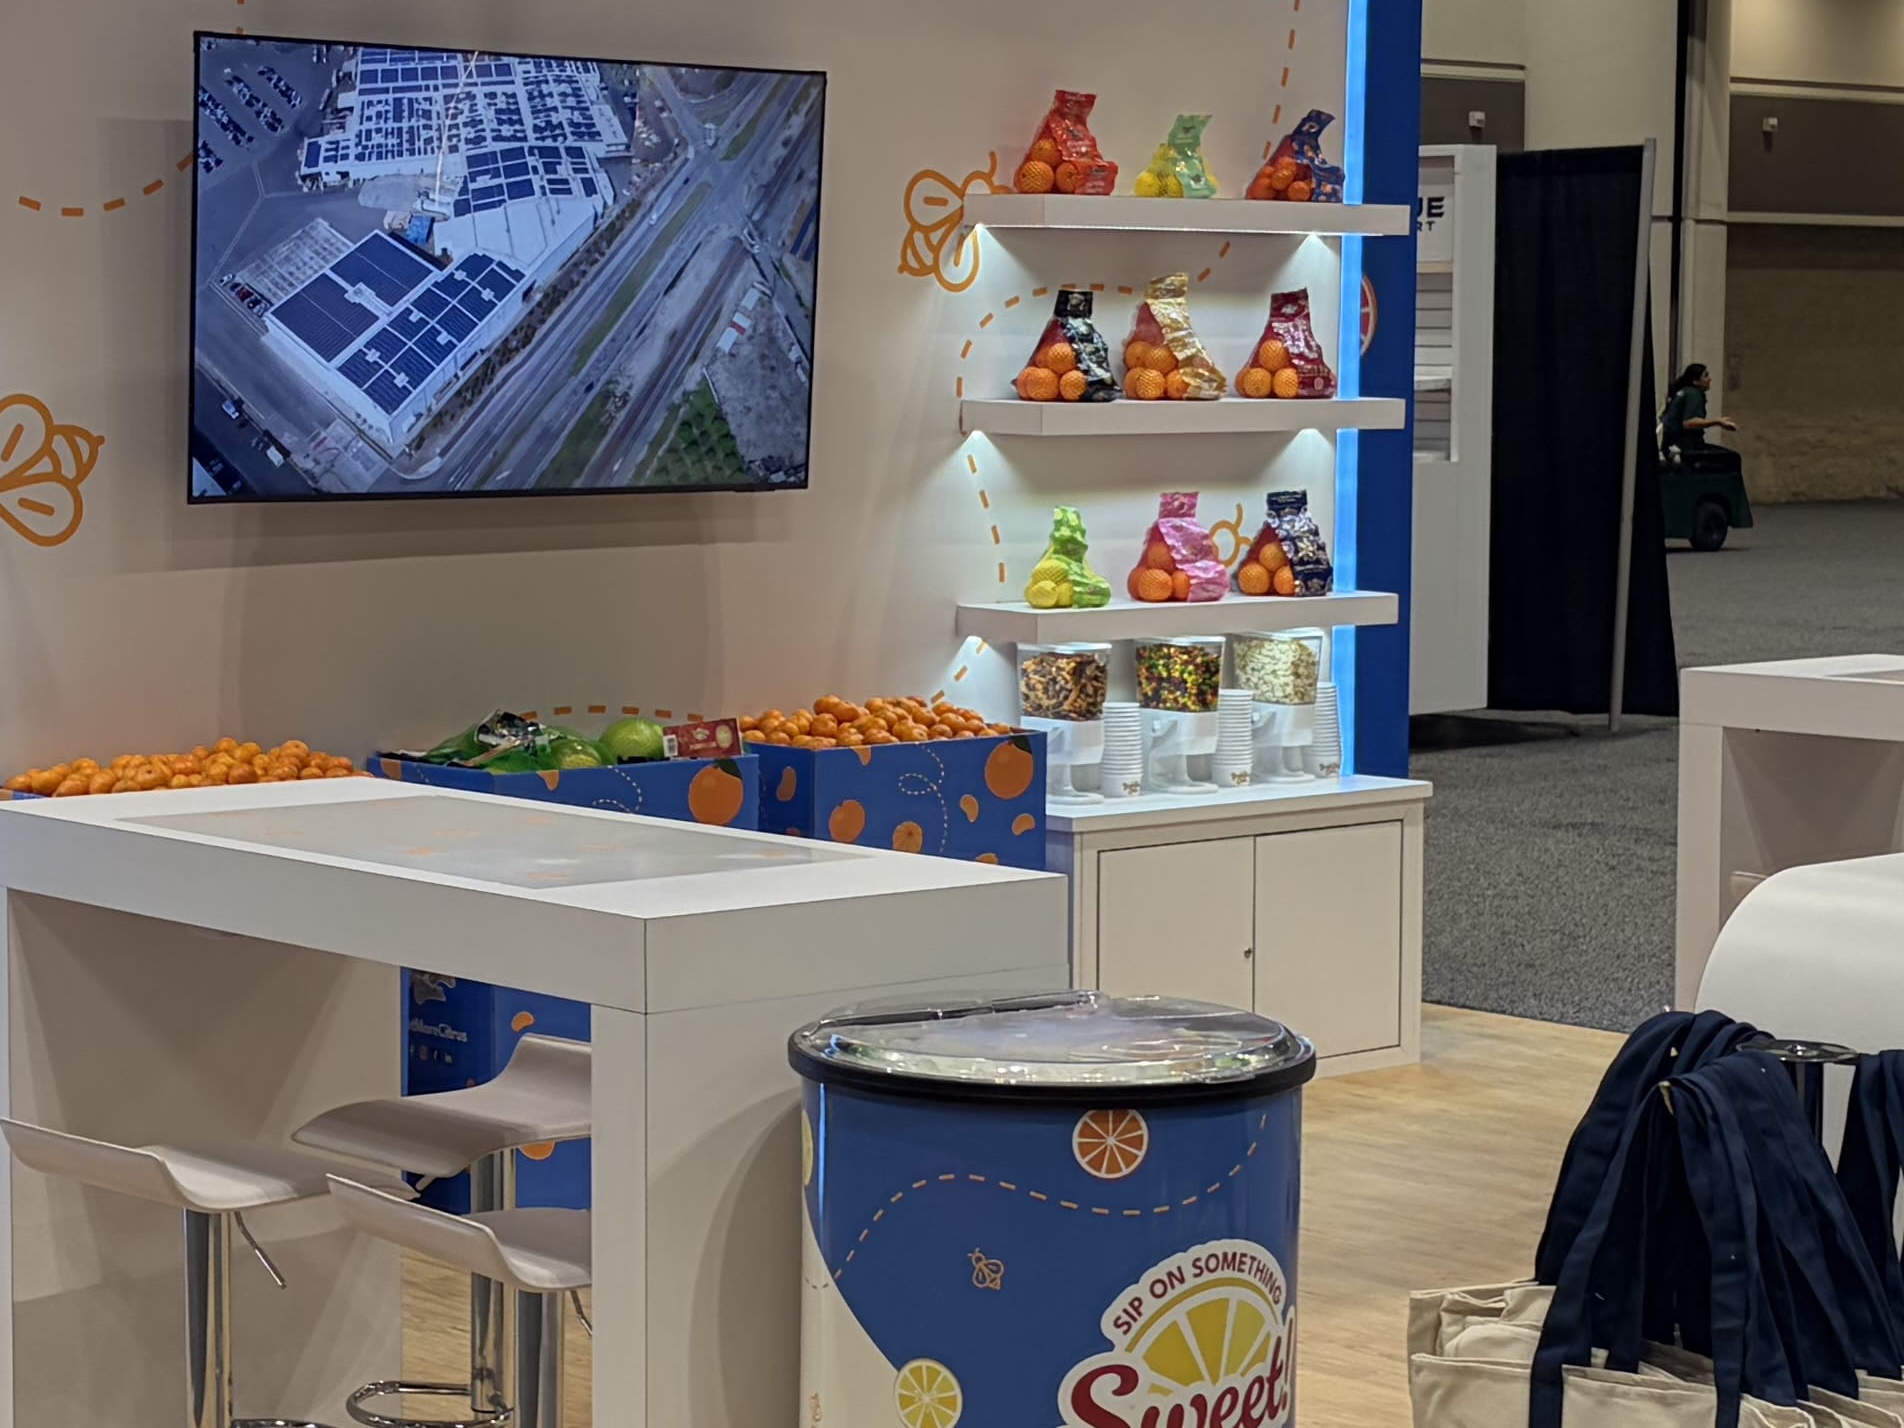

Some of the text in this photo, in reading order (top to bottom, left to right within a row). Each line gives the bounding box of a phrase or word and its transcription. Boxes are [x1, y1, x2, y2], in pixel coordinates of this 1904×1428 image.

[1113, 1251, 1283, 1336] SIP ON SOMETHING
